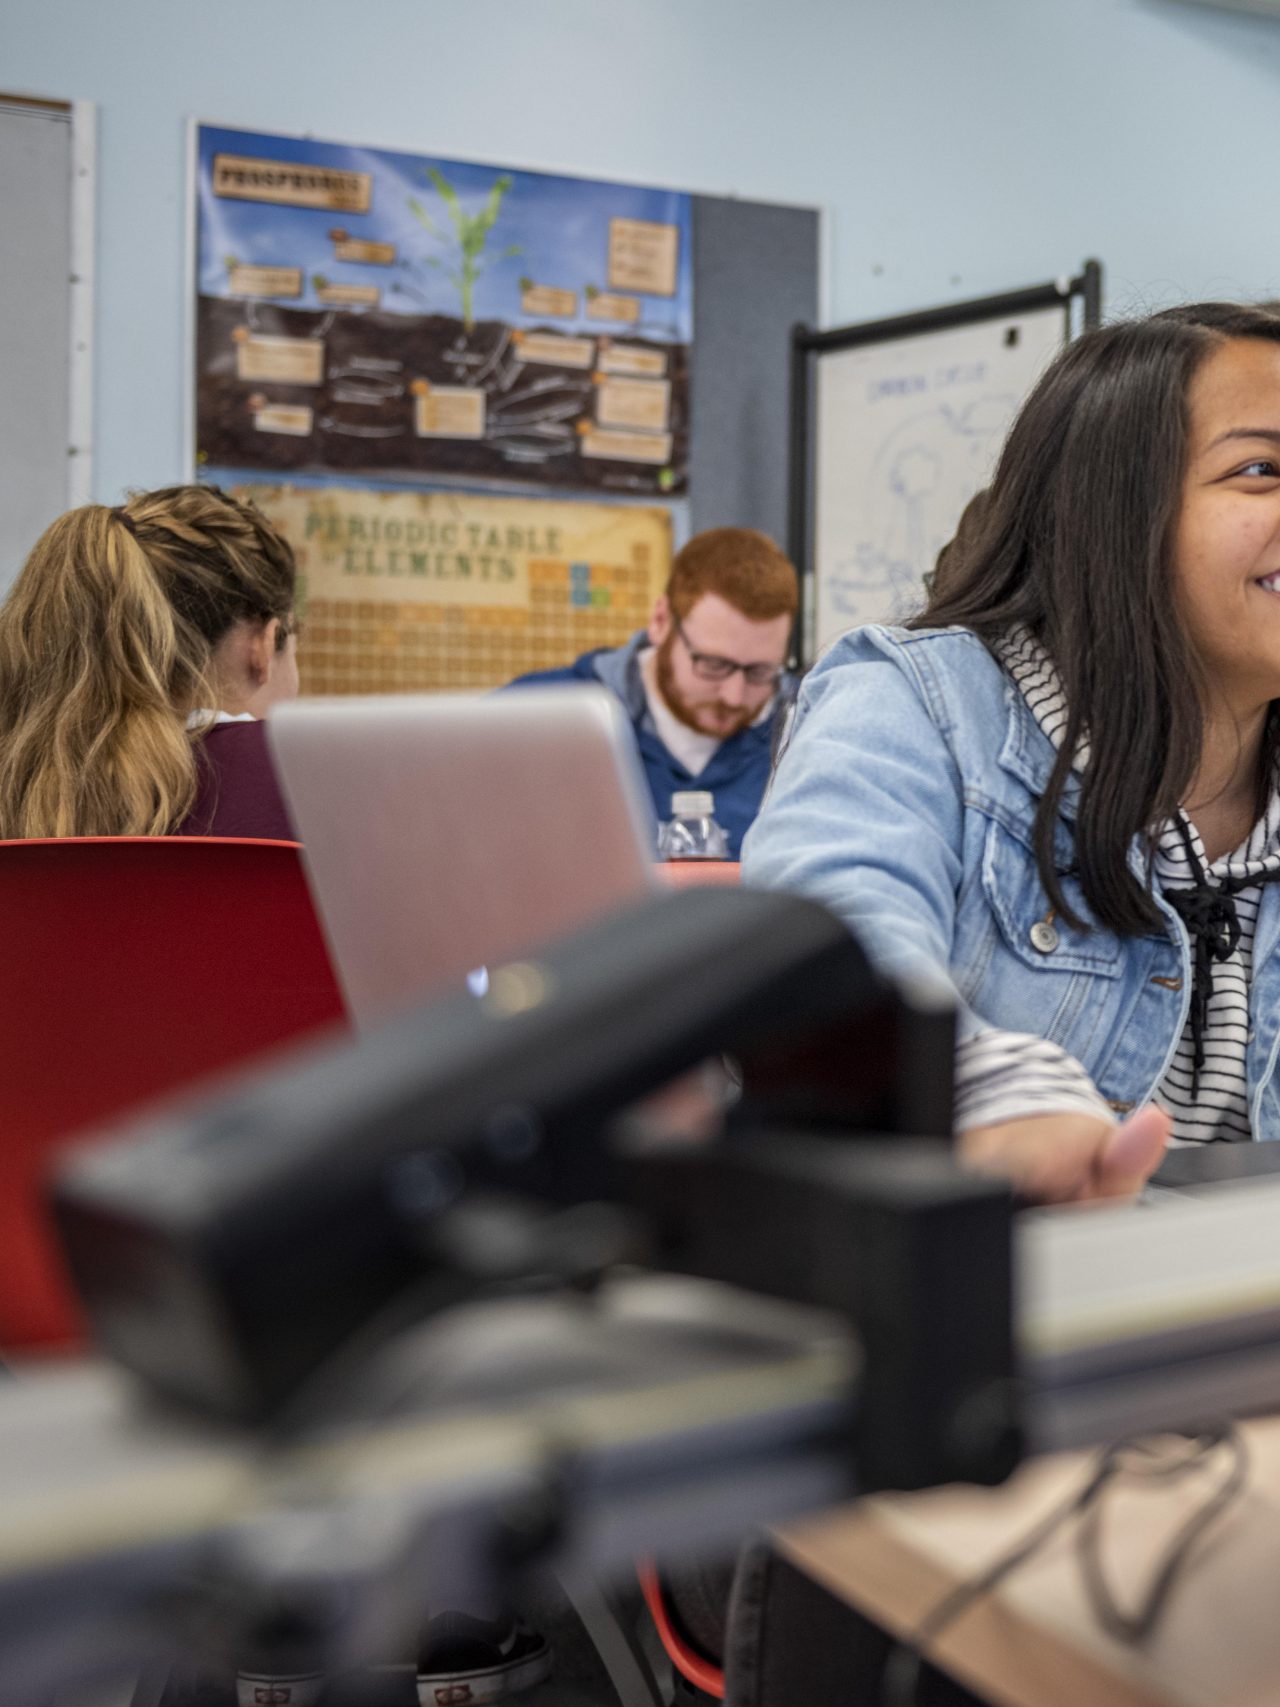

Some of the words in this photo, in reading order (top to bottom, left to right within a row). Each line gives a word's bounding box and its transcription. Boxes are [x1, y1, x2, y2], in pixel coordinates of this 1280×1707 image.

[306, 512, 457, 546] PERIODIC
[465, 521, 560, 553] TABLE
[344, 546, 515, 582] ELEMENTS
